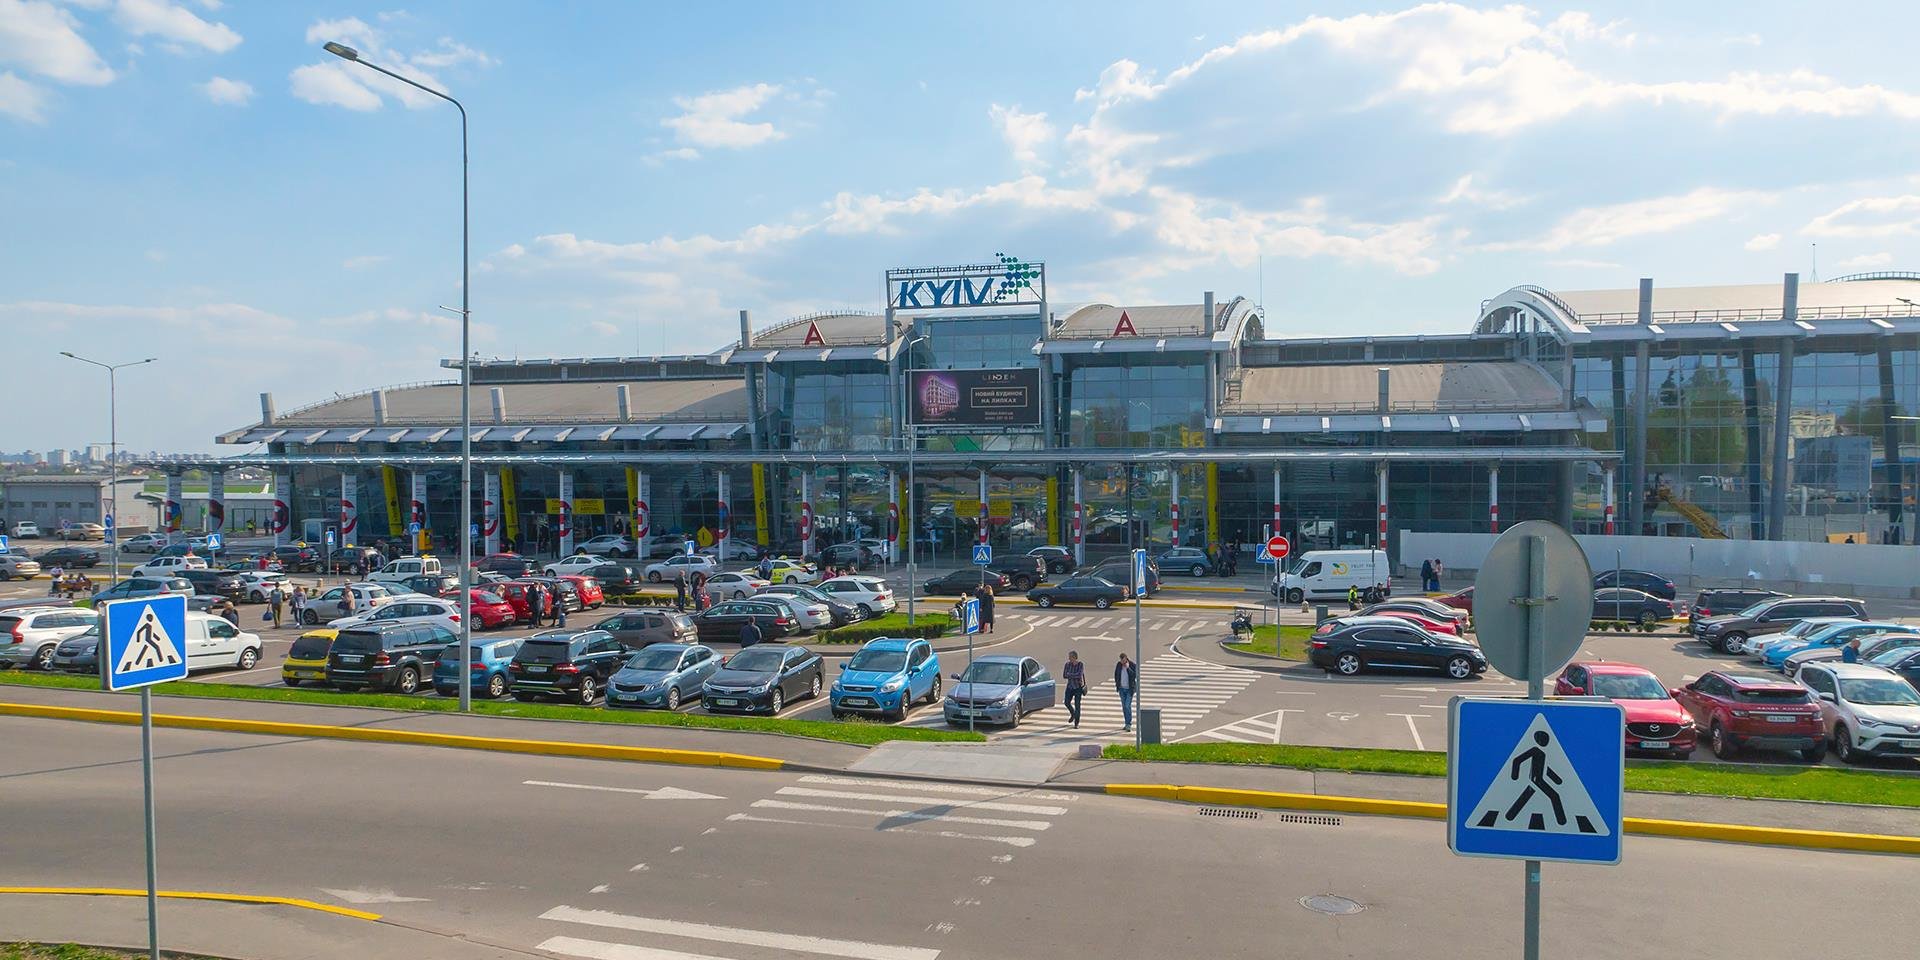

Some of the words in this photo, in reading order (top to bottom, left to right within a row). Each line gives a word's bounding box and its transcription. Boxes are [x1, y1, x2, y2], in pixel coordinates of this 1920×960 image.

[896, 265, 962, 275] International
[965, 263, 1001, 273] Airport
[899, 277, 995, 308] KYIV
[803, 318, 826, 345] A
[1113, 309, 1138, 336] A
